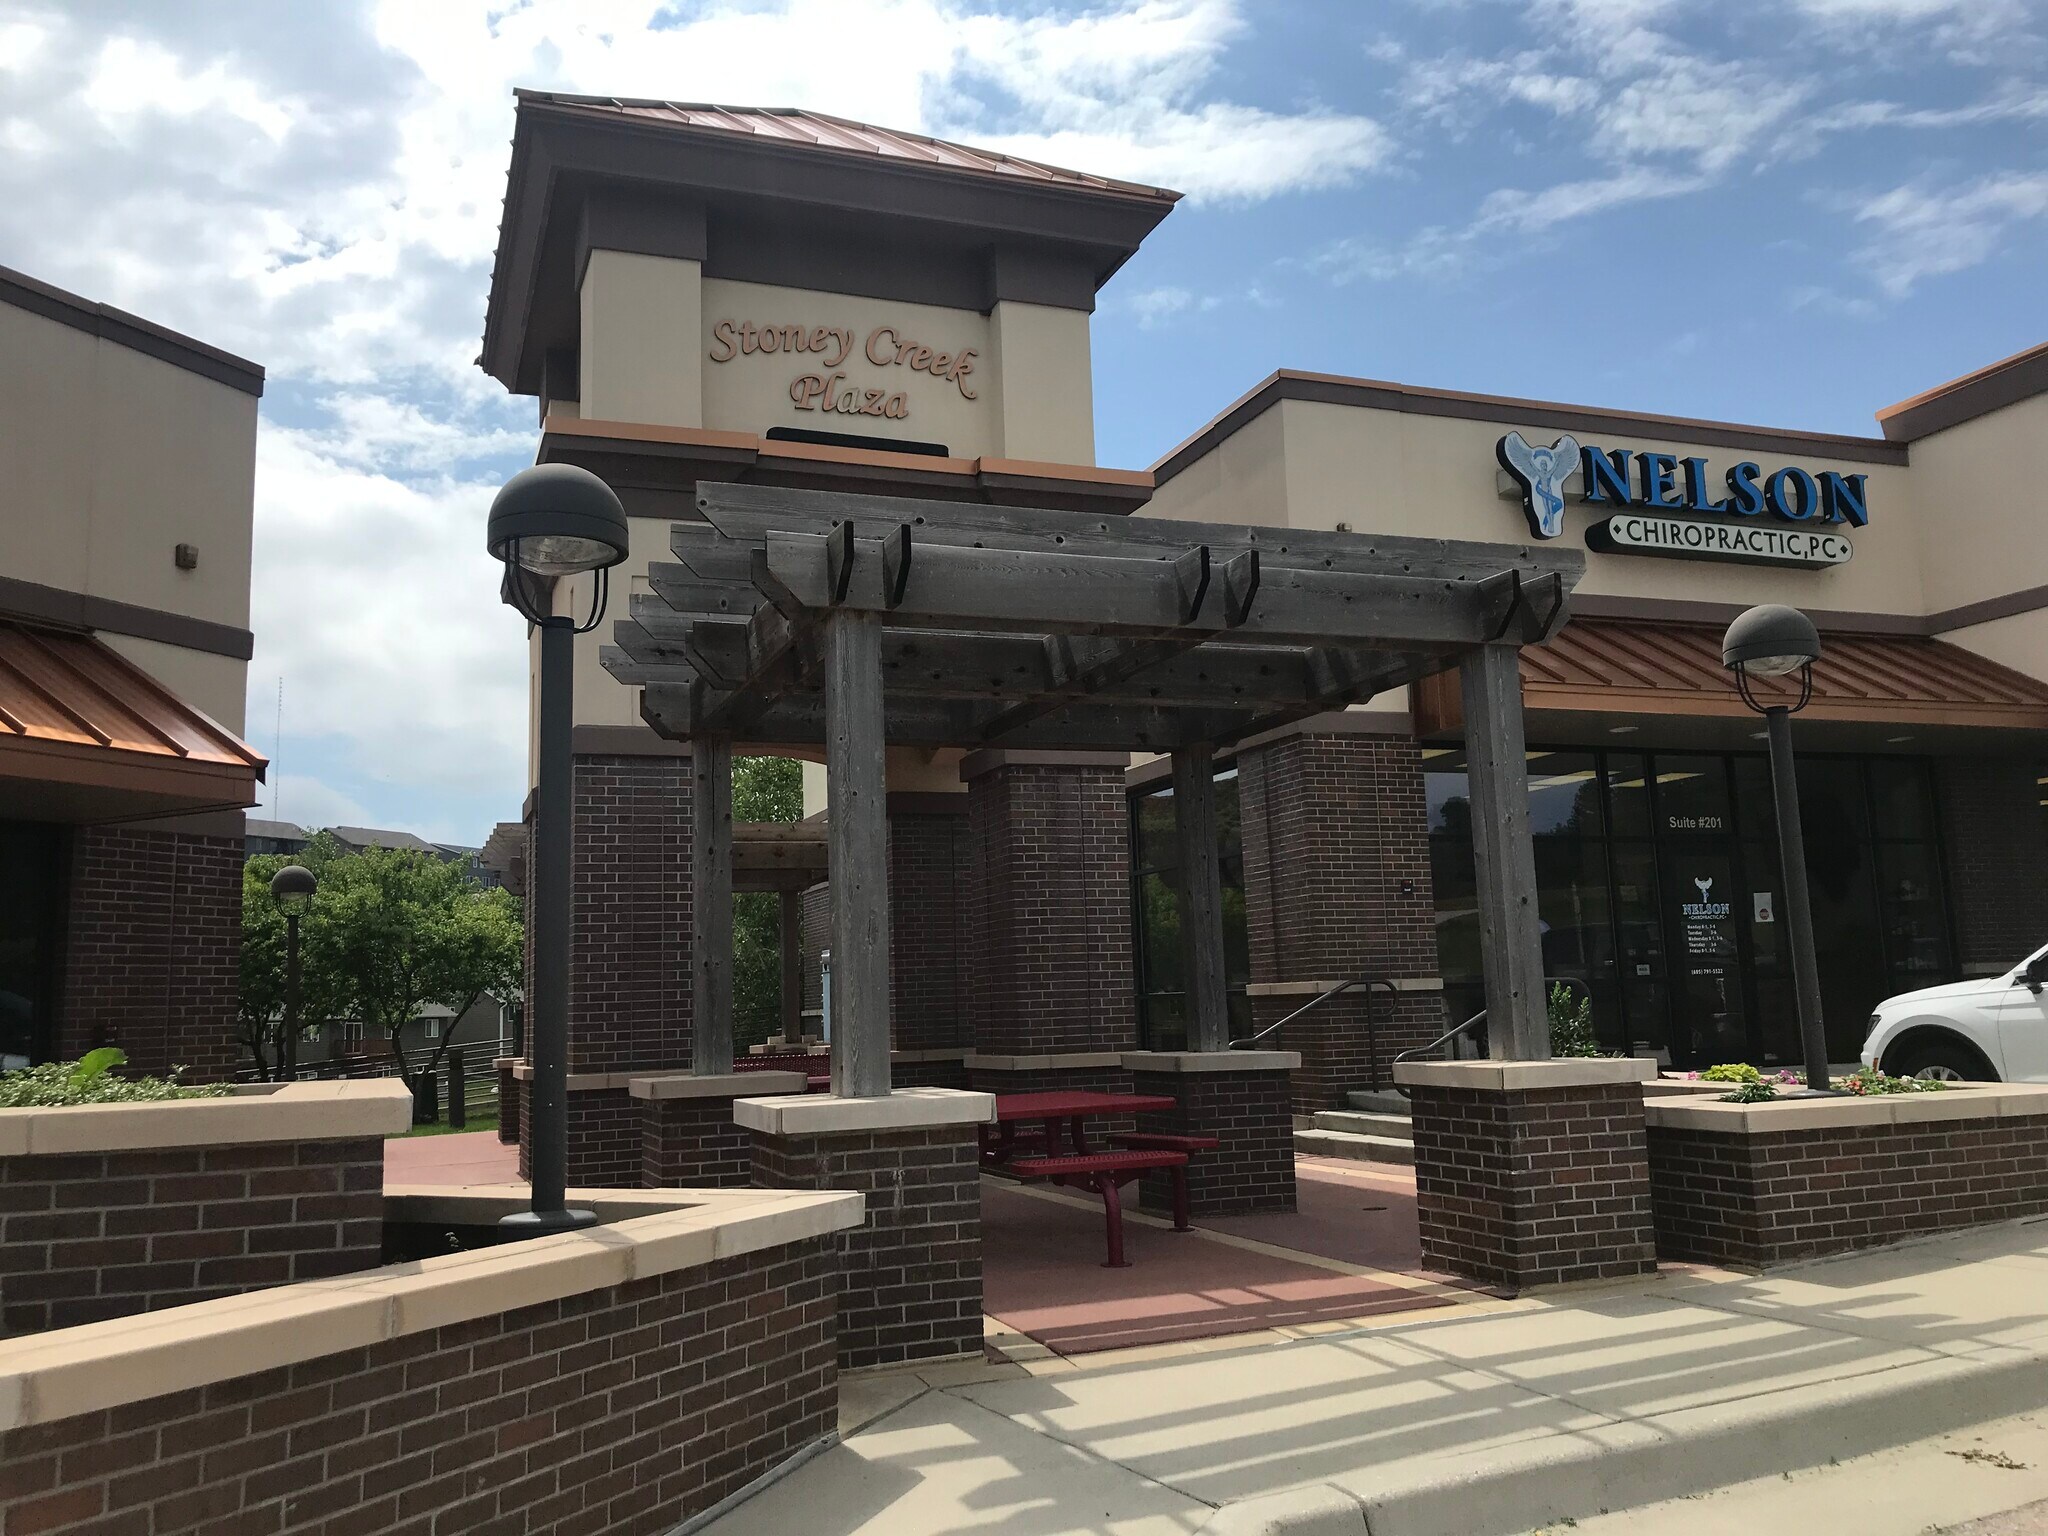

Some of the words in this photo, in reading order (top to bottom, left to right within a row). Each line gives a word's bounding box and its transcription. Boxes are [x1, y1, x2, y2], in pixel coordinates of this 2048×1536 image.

[710, 318, 855, 367] Stoney
[866, 325, 978, 400] Creek
[790, 371, 909, 420] Plaza
[1580, 445, 1868, 528] NELSON
[1669, 816, 1696, 828] Suite
[1698, 816, 1722, 828] #201
[1682, 904, 1729, 915] NELSON
